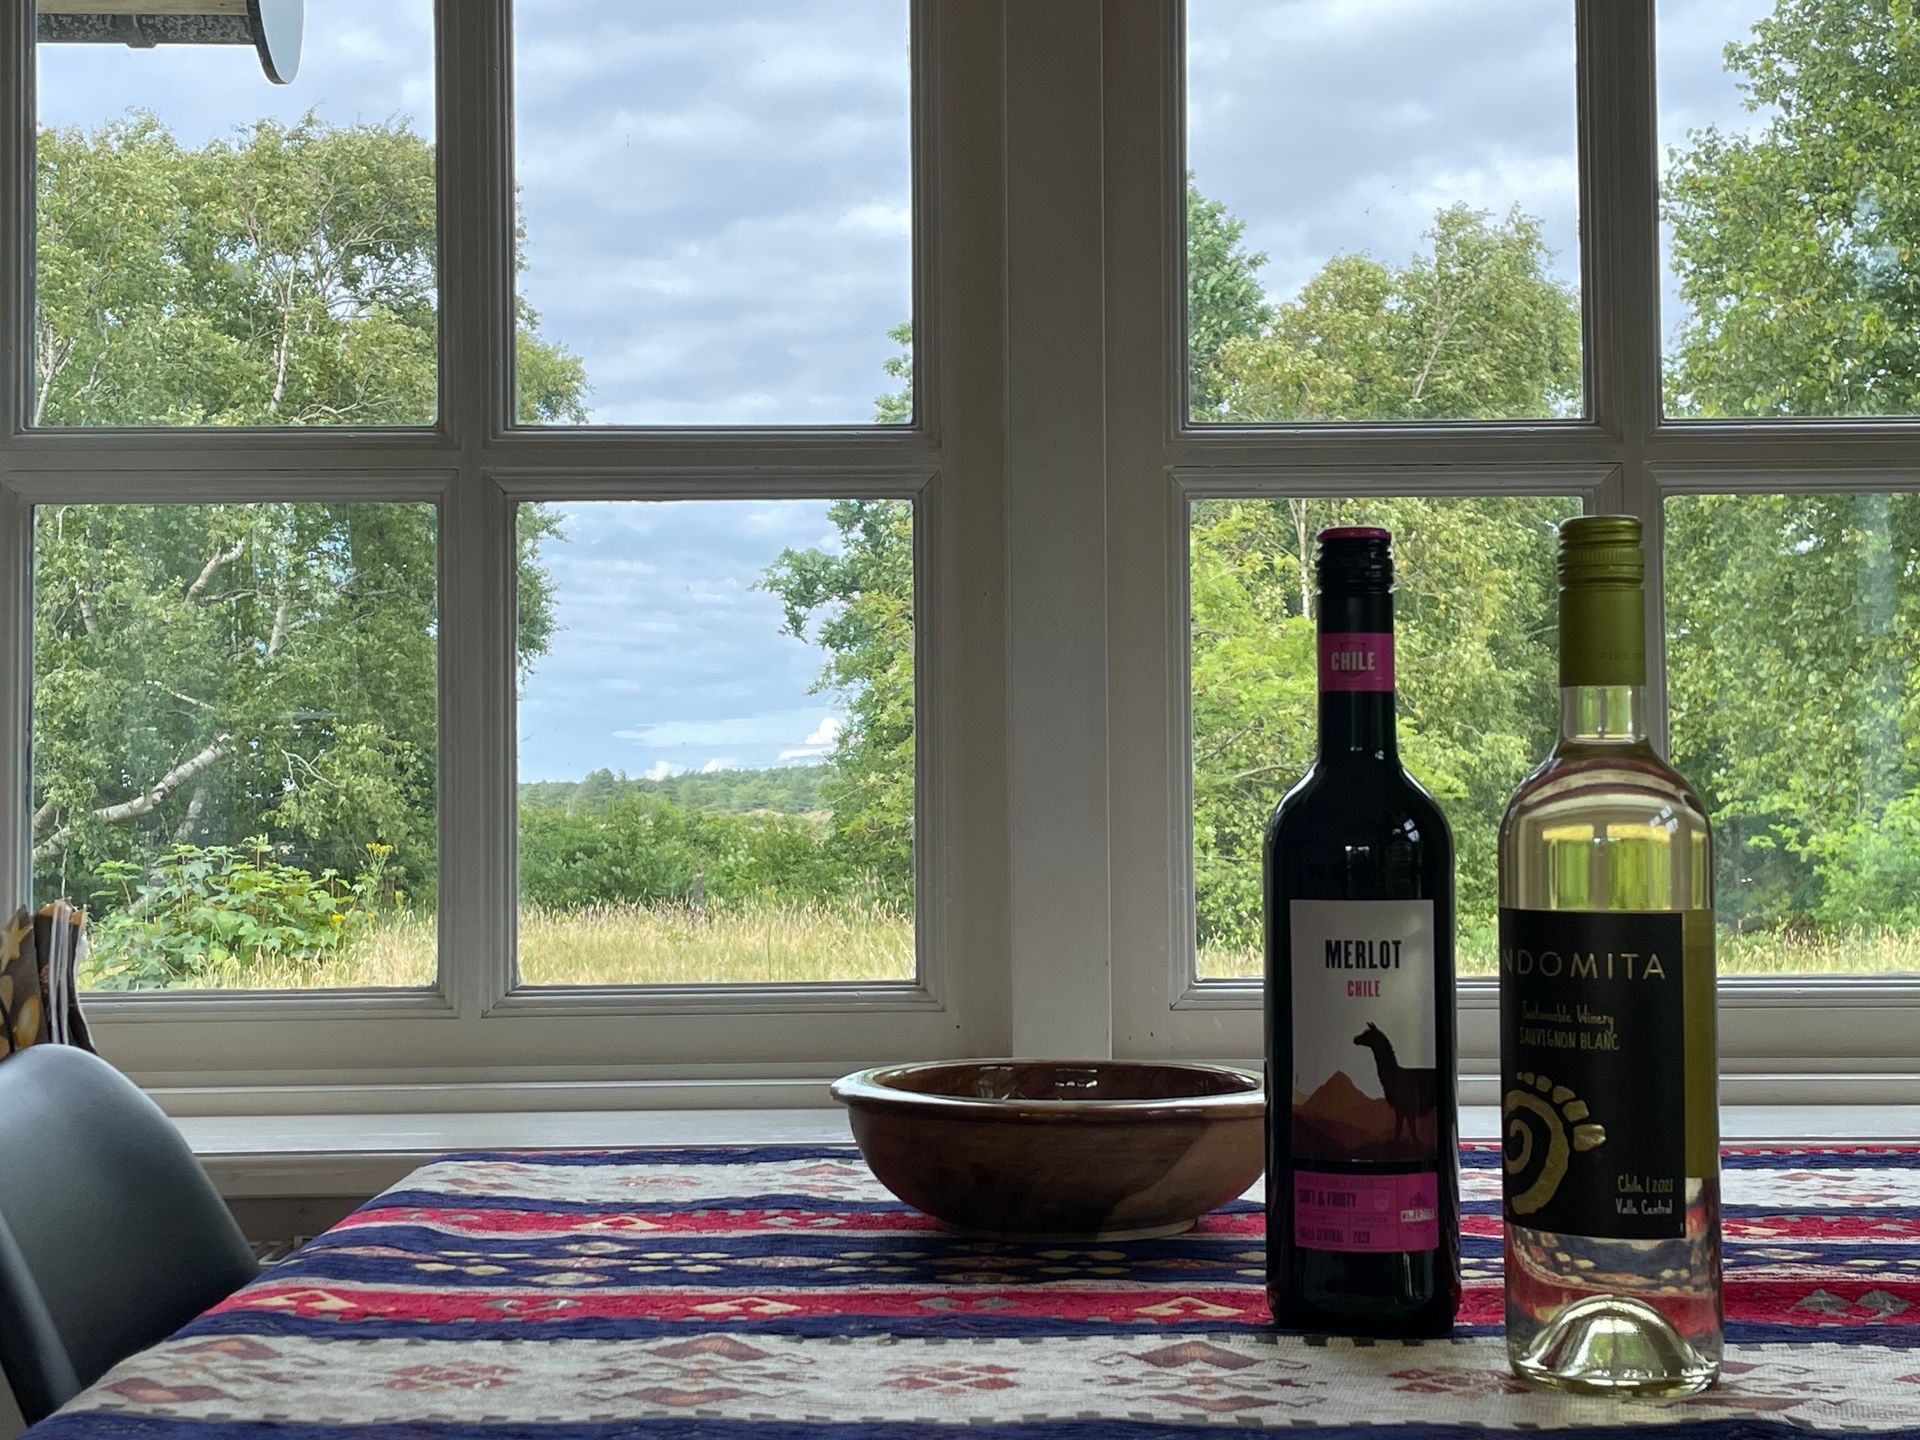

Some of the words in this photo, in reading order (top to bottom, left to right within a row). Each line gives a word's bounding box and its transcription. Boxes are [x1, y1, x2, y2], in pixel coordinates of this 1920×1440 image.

[1330, 651, 1376, 671] CHILE
[1325, 939, 1402, 970] MERLOT
[1502, 946, 1666, 980] NDOMITA
[1347, 980, 1381, 998] CHILE
[1576, 1003, 1615, 1035] Winery
[1519, 1026, 1576, 1048] SAUVIGNON
[1580, 1031, 1620, 1051] BLANC
[1617, 1173, 1644, 1193] Chile
[1652, 1178, 1673, 1193] 2021
[1615, 1198, 1638, 1215] Valle
[1641, 1198, 1673, 1215] Central
